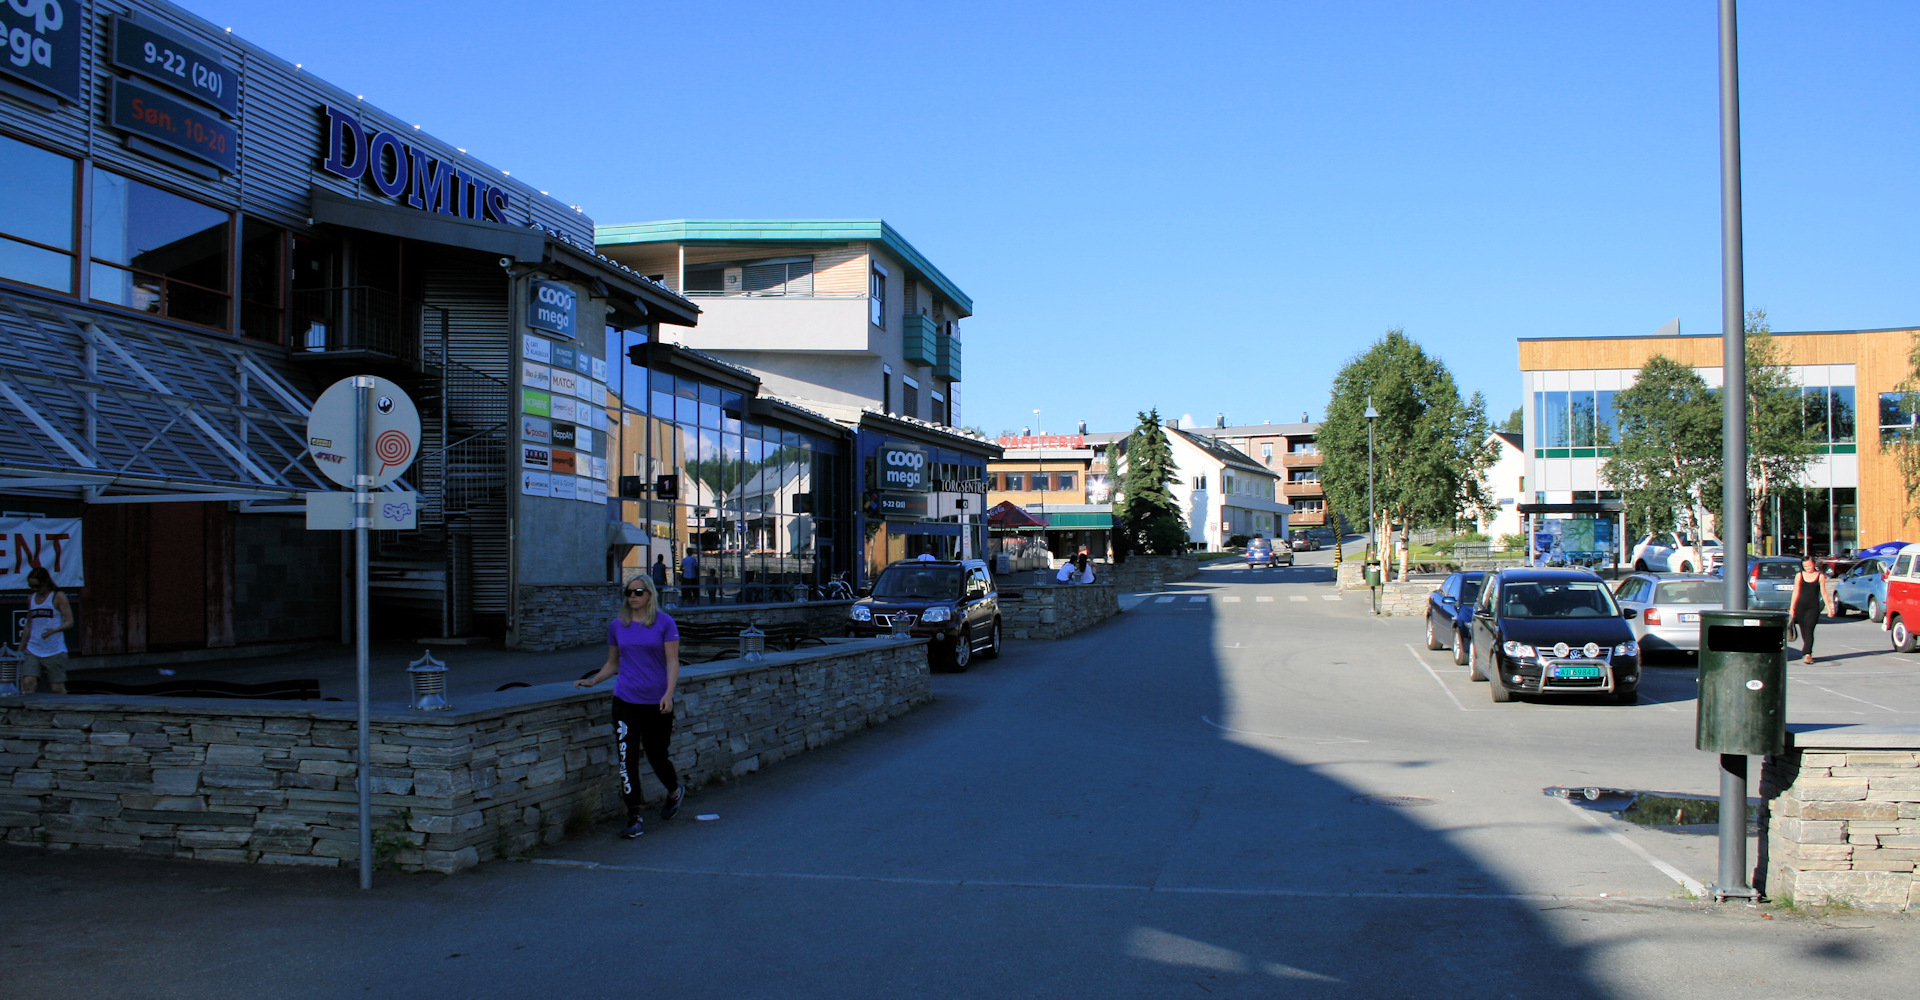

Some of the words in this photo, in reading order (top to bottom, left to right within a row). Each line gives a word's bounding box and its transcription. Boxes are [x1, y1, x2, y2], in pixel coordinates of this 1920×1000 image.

[144, 41, 187, 78] 9-22
[192, 61, 223, 99] (20)
[131, 98, 177, 133] Søn.
[185, 118, 226, 154] 10-20
[323, 105, 509, 225] DOMUS
[538, 286, 572, 312] coop
[538, 308, 569, 330] mega
[552, 375, 576, 389] MATCH
[531, 429, 549, 438] posten
[552, 429, 574, 441] KappAhl
[999, 435, 1086, 449] KAFETERIA
[886, 451, 924, 471] coop
[886, 470, 921, 488] mega
[941, 479, 989, 494] TORGSENTRET
[882, 500, 895, 508] 9-22
[1560, 668, 1569, 676] AJ
[1573, 668, 1597, 676] 69843
